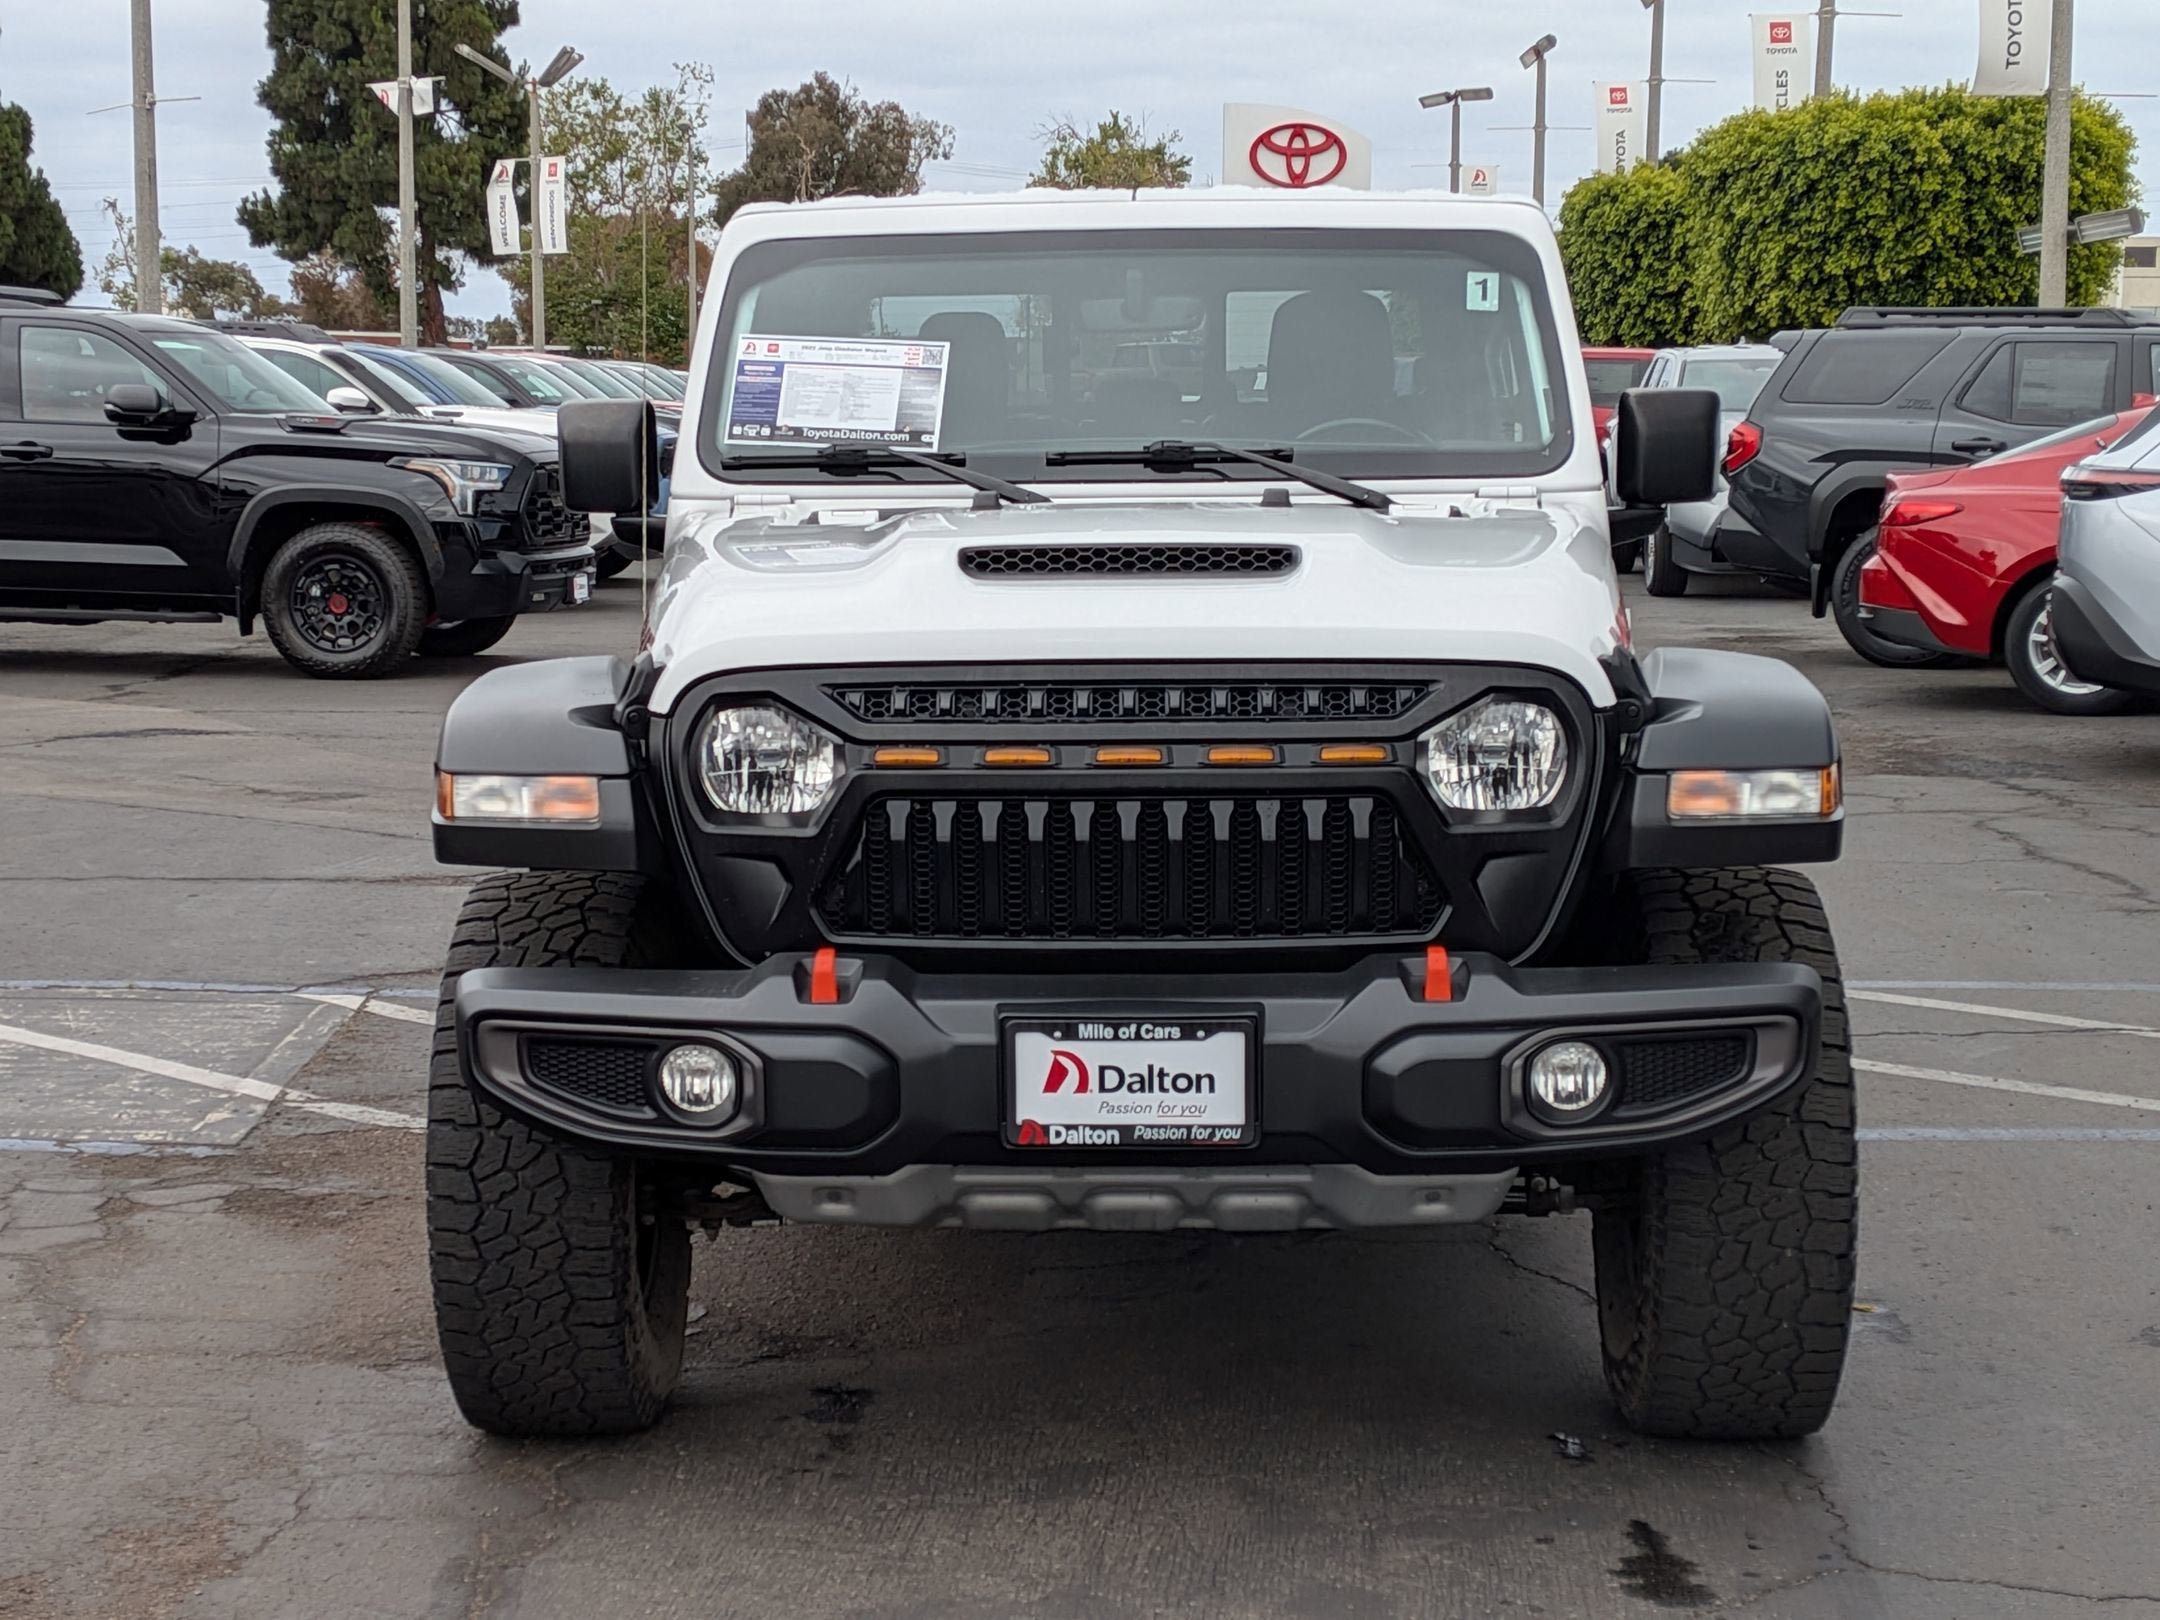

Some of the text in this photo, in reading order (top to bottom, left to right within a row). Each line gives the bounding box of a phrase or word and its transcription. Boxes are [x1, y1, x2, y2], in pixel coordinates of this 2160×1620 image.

[2005, 0, 2022, 70] TOYOT
[1776, 69, 1788, 108] CLES
[1616, 129, 1626, 177] OYOTA
[500, 194, 508, 247] WELCOME
[1475, 278, 1488, 301] 1
[802, 427, 910, 442] ToyotaDalton.com
[1078, 1023, 1182, 1040] Mile of Cars
[1098, 1064, 1216, 1094] Dalton
[1097, 1101, 1208, 1117] Passion for you
[1049, 1125, 1242, 1145] Dalton Passion for you
